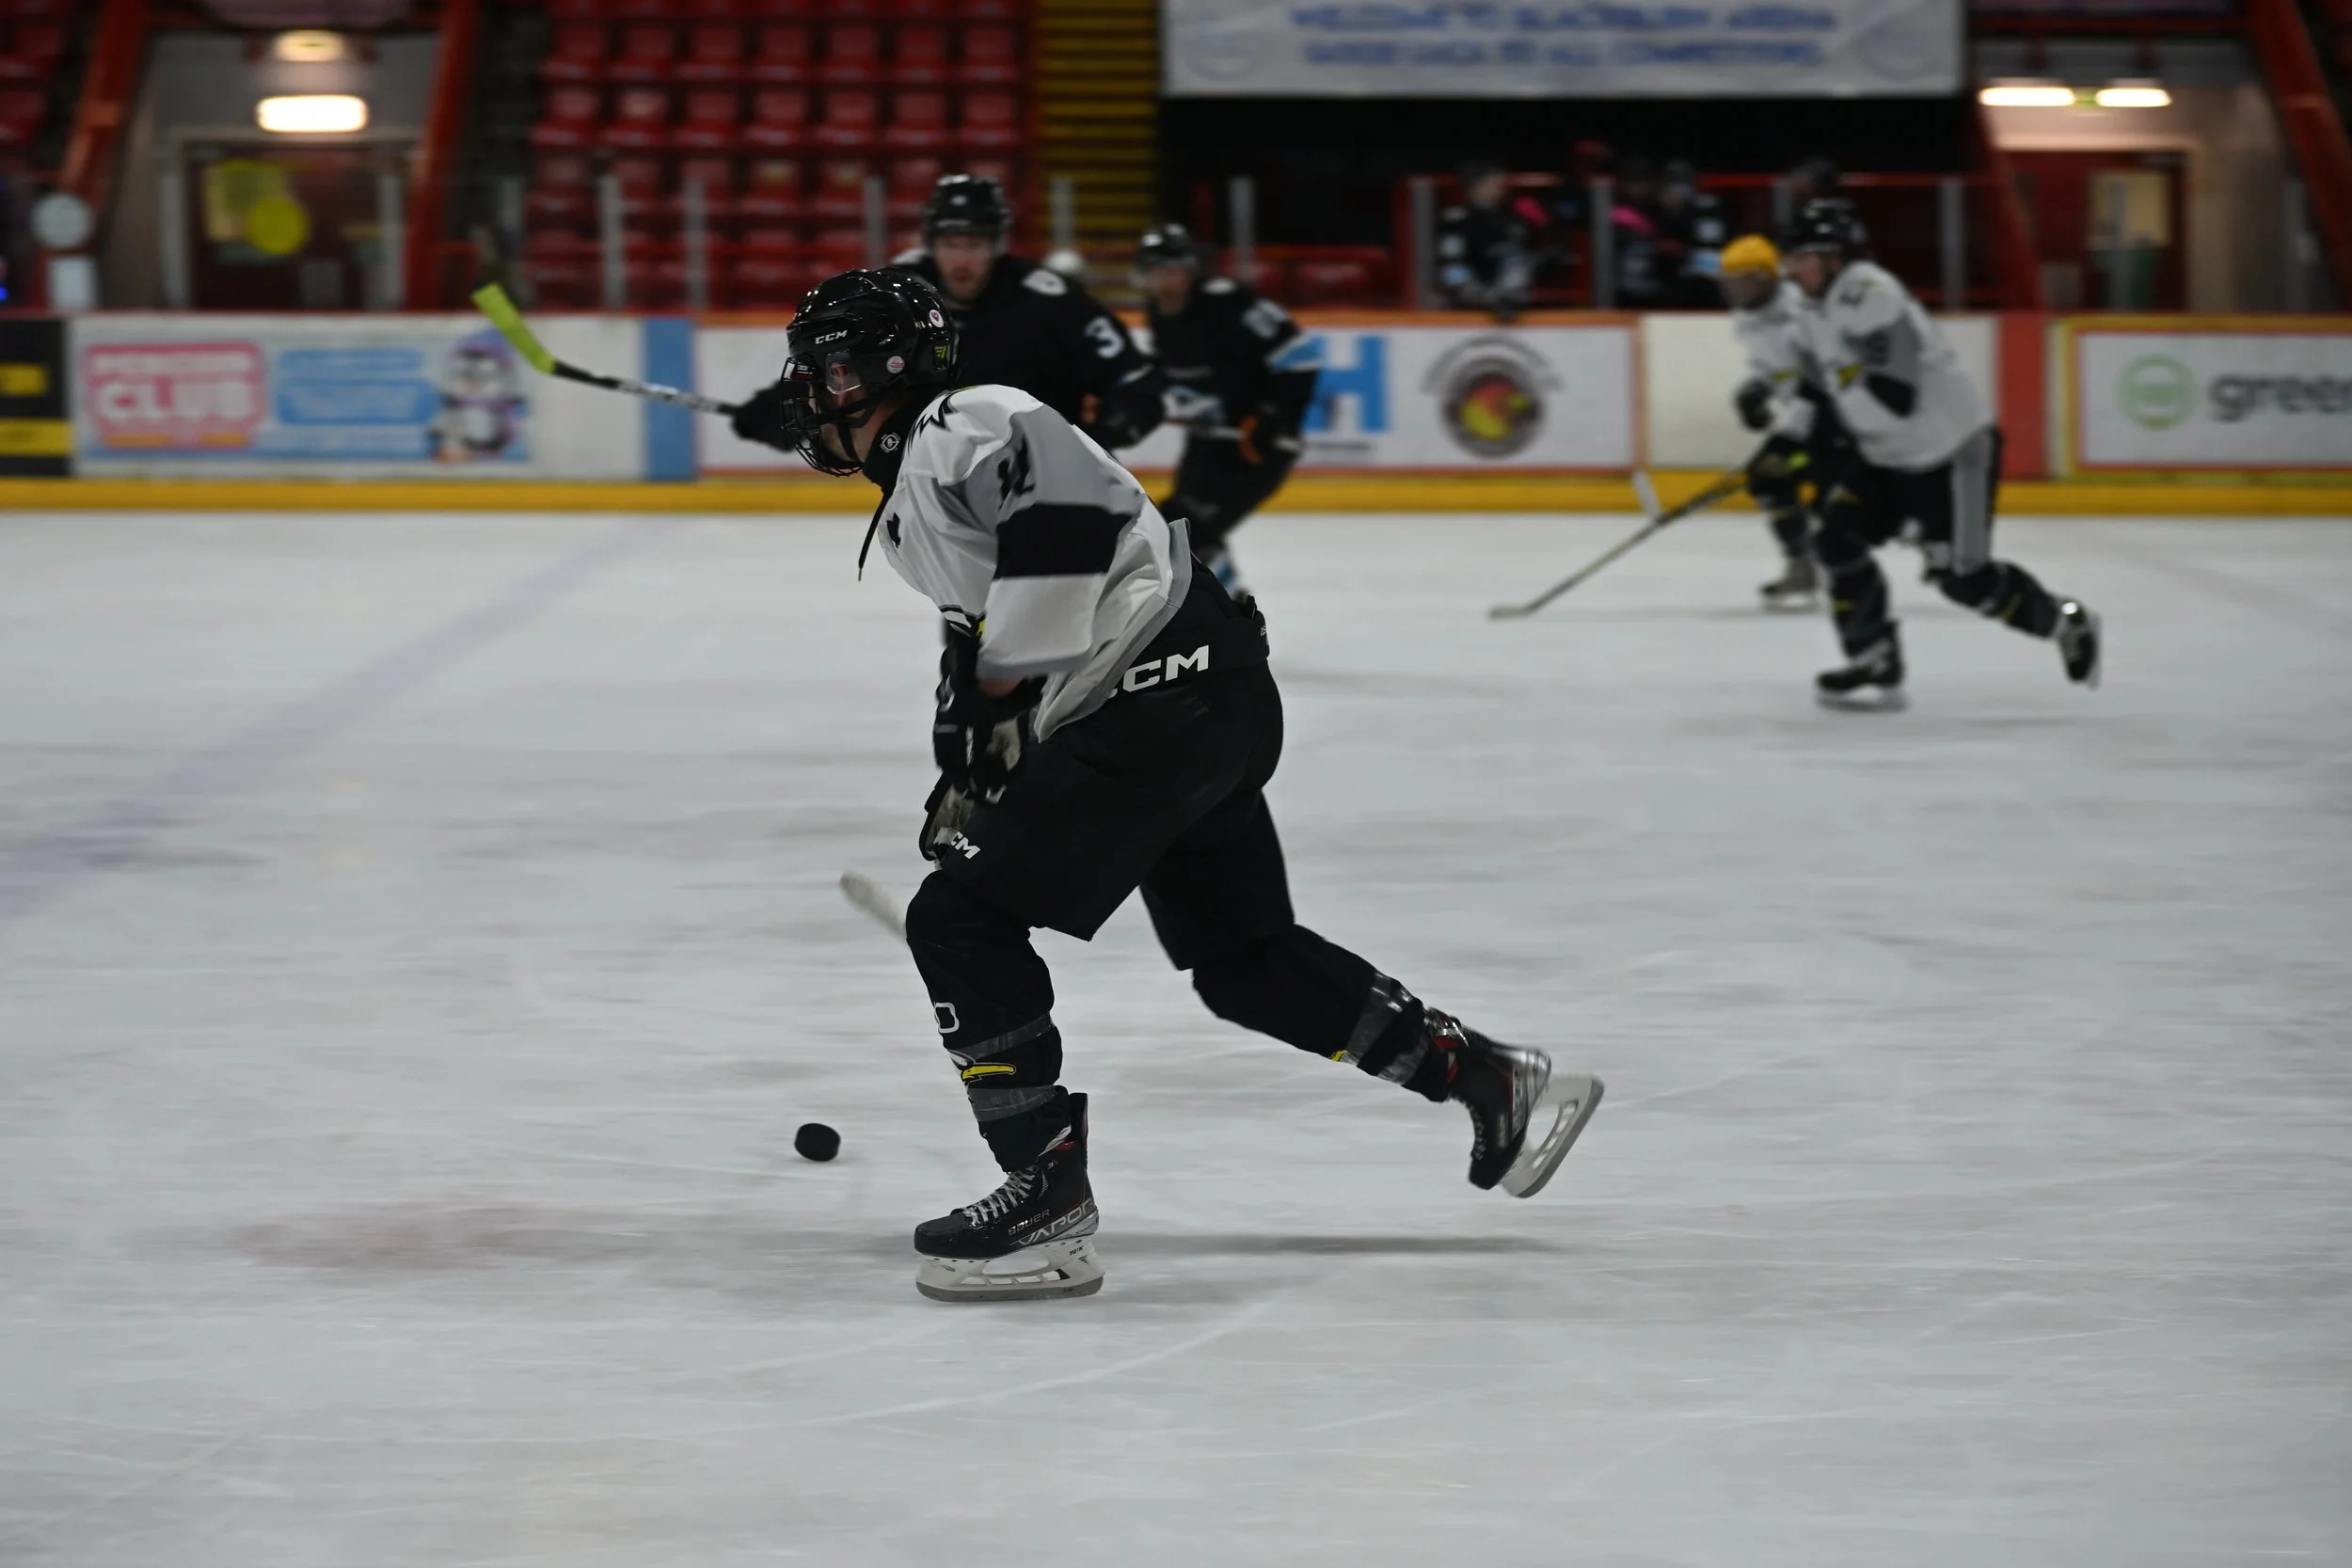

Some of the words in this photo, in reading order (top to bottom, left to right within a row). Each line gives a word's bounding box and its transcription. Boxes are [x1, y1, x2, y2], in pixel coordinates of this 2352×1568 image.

[815, 330, 848, 345] CCM
[1085, 316, 1124, 358] 3
[1108, 644, 1210, 699] CM
[951, 831, 981, 860] CM
